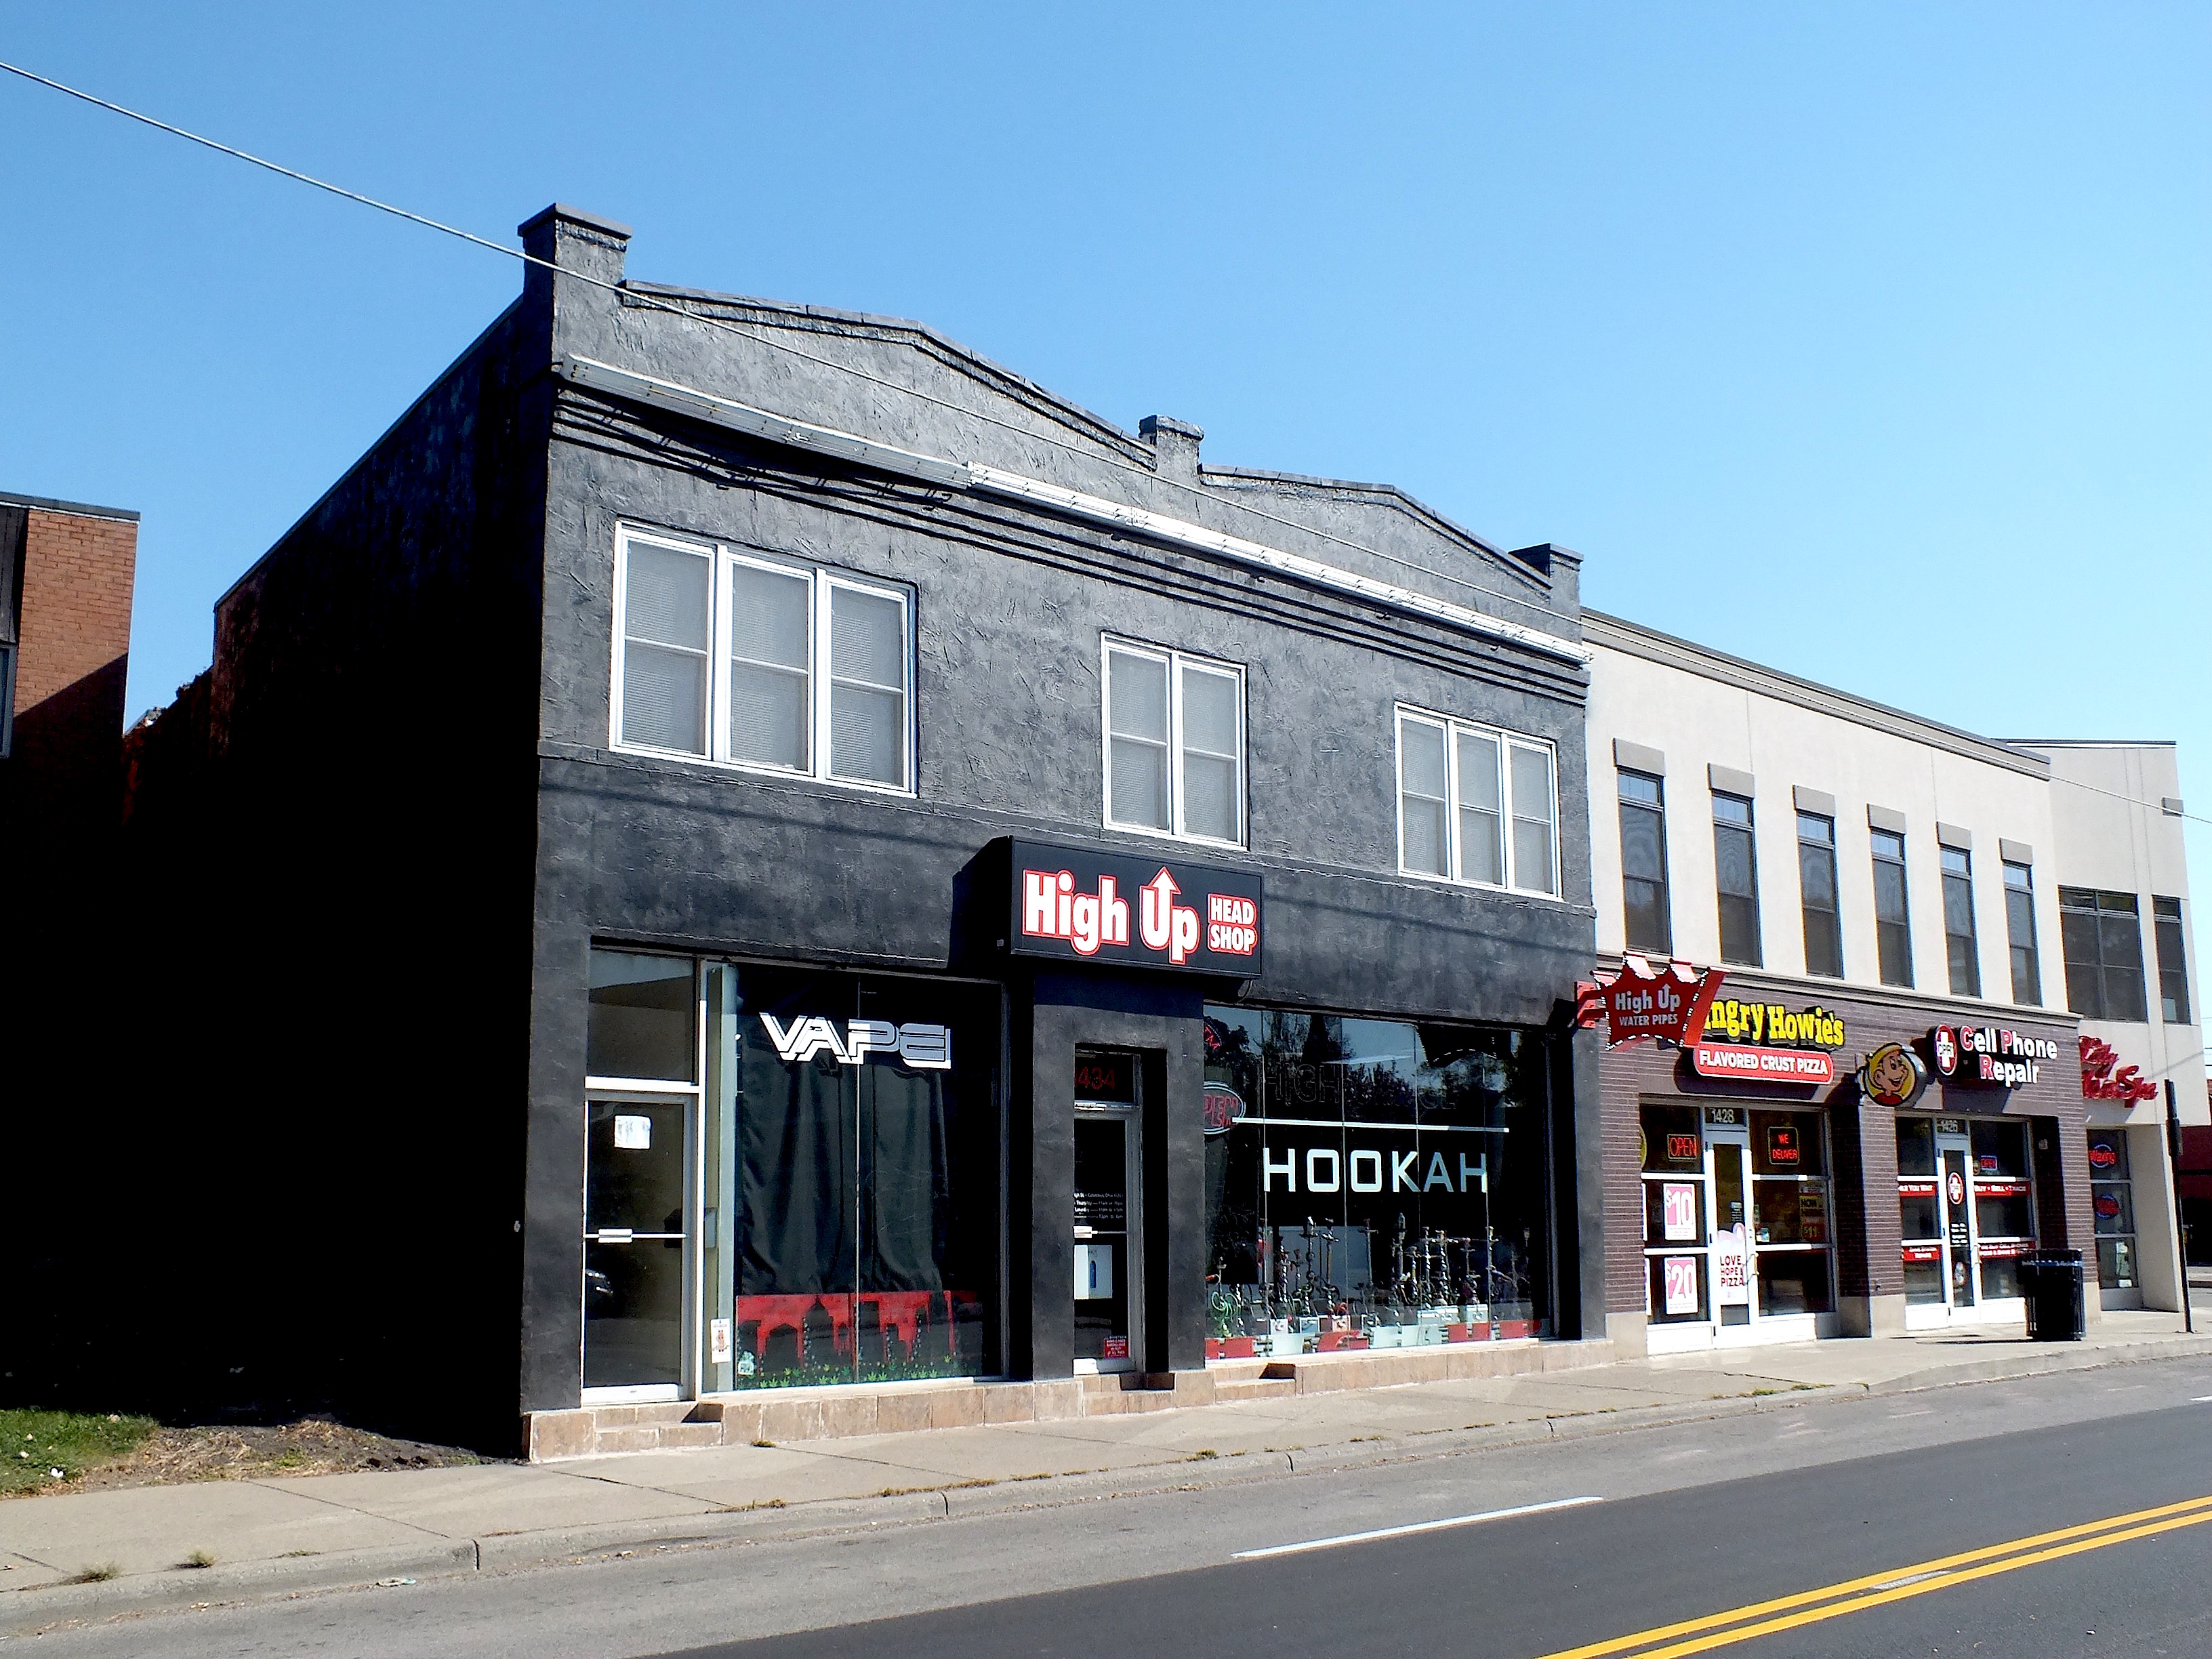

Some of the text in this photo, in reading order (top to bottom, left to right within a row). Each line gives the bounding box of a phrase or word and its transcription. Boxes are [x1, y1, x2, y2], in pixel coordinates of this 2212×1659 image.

[1023, 866, 1200, 964] High Up
[1209, 895, 1255, 925] HEAD
[1209, 924, 1256, 954] SHOP
[1615, 983, 1681, 1014] High Up
[1619, 1013, 1678, 1026] WATER PIPES
[1704, 1000, 1845, 1046] ngry Howie's
[759, 1012, 951, 1069] VAPE
[1960, 1025, 1997, 1052] Cell
[2000, 1029, 2058, 1059] Phone
[1699, 1050, 1828, 1074] FLAVORED CRUST PIZZA
[1979, 1054, 2040, 1087] Repair
[1711, 1108, 1735, 1123] 1428
[1668, 1137, 1696, 1156] OPEN
[1778, 1134, 1789, 1143] WE
[1772, 1149, 1797, 1159] DELIVER
[1263, 1147, 1488, 1193] HOOKAH
[1666, 1189, 1693, 1225] $10
[1666, 1264, 1694, 1298] $20
[1720, 1267, 1738, 1275] HOPE
[1721, 1277, 1745, 1287] PIZZA
